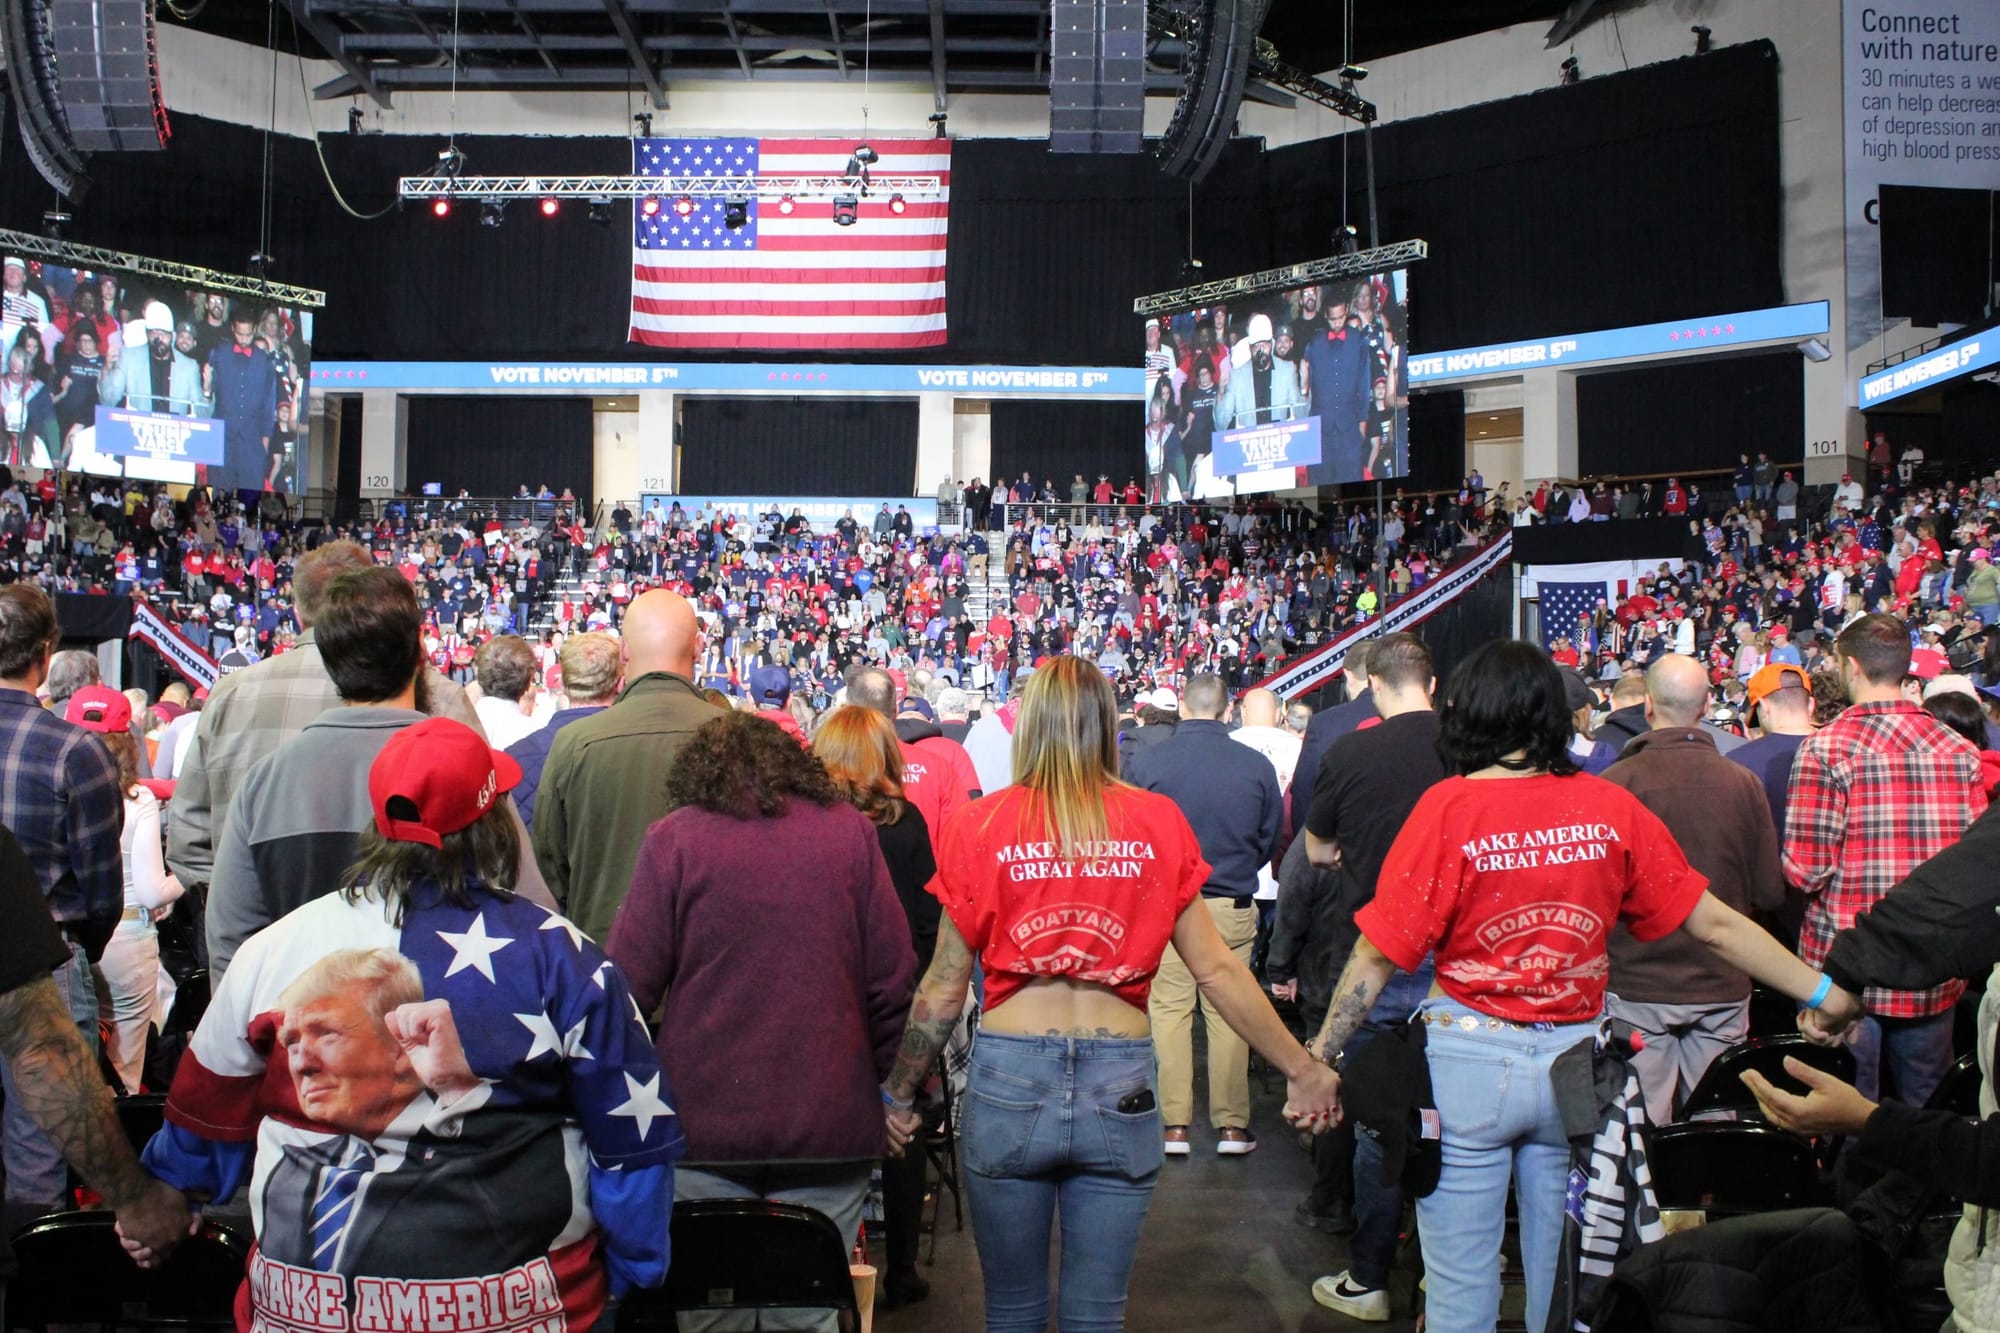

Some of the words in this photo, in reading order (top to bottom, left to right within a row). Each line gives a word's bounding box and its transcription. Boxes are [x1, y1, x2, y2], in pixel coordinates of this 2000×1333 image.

[1861, 8, 1960, 34] Connect
[1861, 36, 1913, 60] with
[1922, 40, 1998, 62] nature
[1861, 68, 1883, 87] 30
[1889, 69, 1955, 89] minutes
[1961, 75, 1971, 89] a
[1862, 95, 1891, 111] can
[1898, 92, 1933, 116] help
[1862, 115, 1879, 134] of
[1885, 116, 1975, 138] depression
[1863, 139, 1897, 162] high
[1904, 141, 1949, 159] blood
[1447, 344, 1546, 372] NOVEMBER
[1550, 340, 1577, 359] 5TH
[490, 367, 540, 383] VOTE
[544, 367, 648, 384] NOVEMBER
[652, 368, 678, 383] 5TH
[918, 370, 968, 386] VOTE
[972, 371, 1078, 387] NOVEMBER
[1082, 372, 1108, 387] 5TH
[1863, 373, 1894, 400] VOTE
[1894, 350, 1960, 390] NOVEMBER
[1812, 440, 1837, 455] 101
[367, 475, 389, 487] 120
[643, 478, 664, 489] 121
[996, 841, 1056, 863] MAKE
[1461, 832, 1519, 860] MAKE
[1522, 824, 1621, 848] AMERICA
[1475, 850, 1540, 873] GREAT
[1544, 843, 1608, 866] AGAIN
[1010, 861, 1076, 882] GREAT
[1080, 861, 1143, 878] AGAIN
[1016, 909, 1124, 940] BOATYARD
[1484, 908, 1595, 941] BOATYARD
[1519, 956, 1559, 971] BAR
[251, 1250, 346, 1330] MAKE
[355, 1257, 561, 1333] AMERICA
